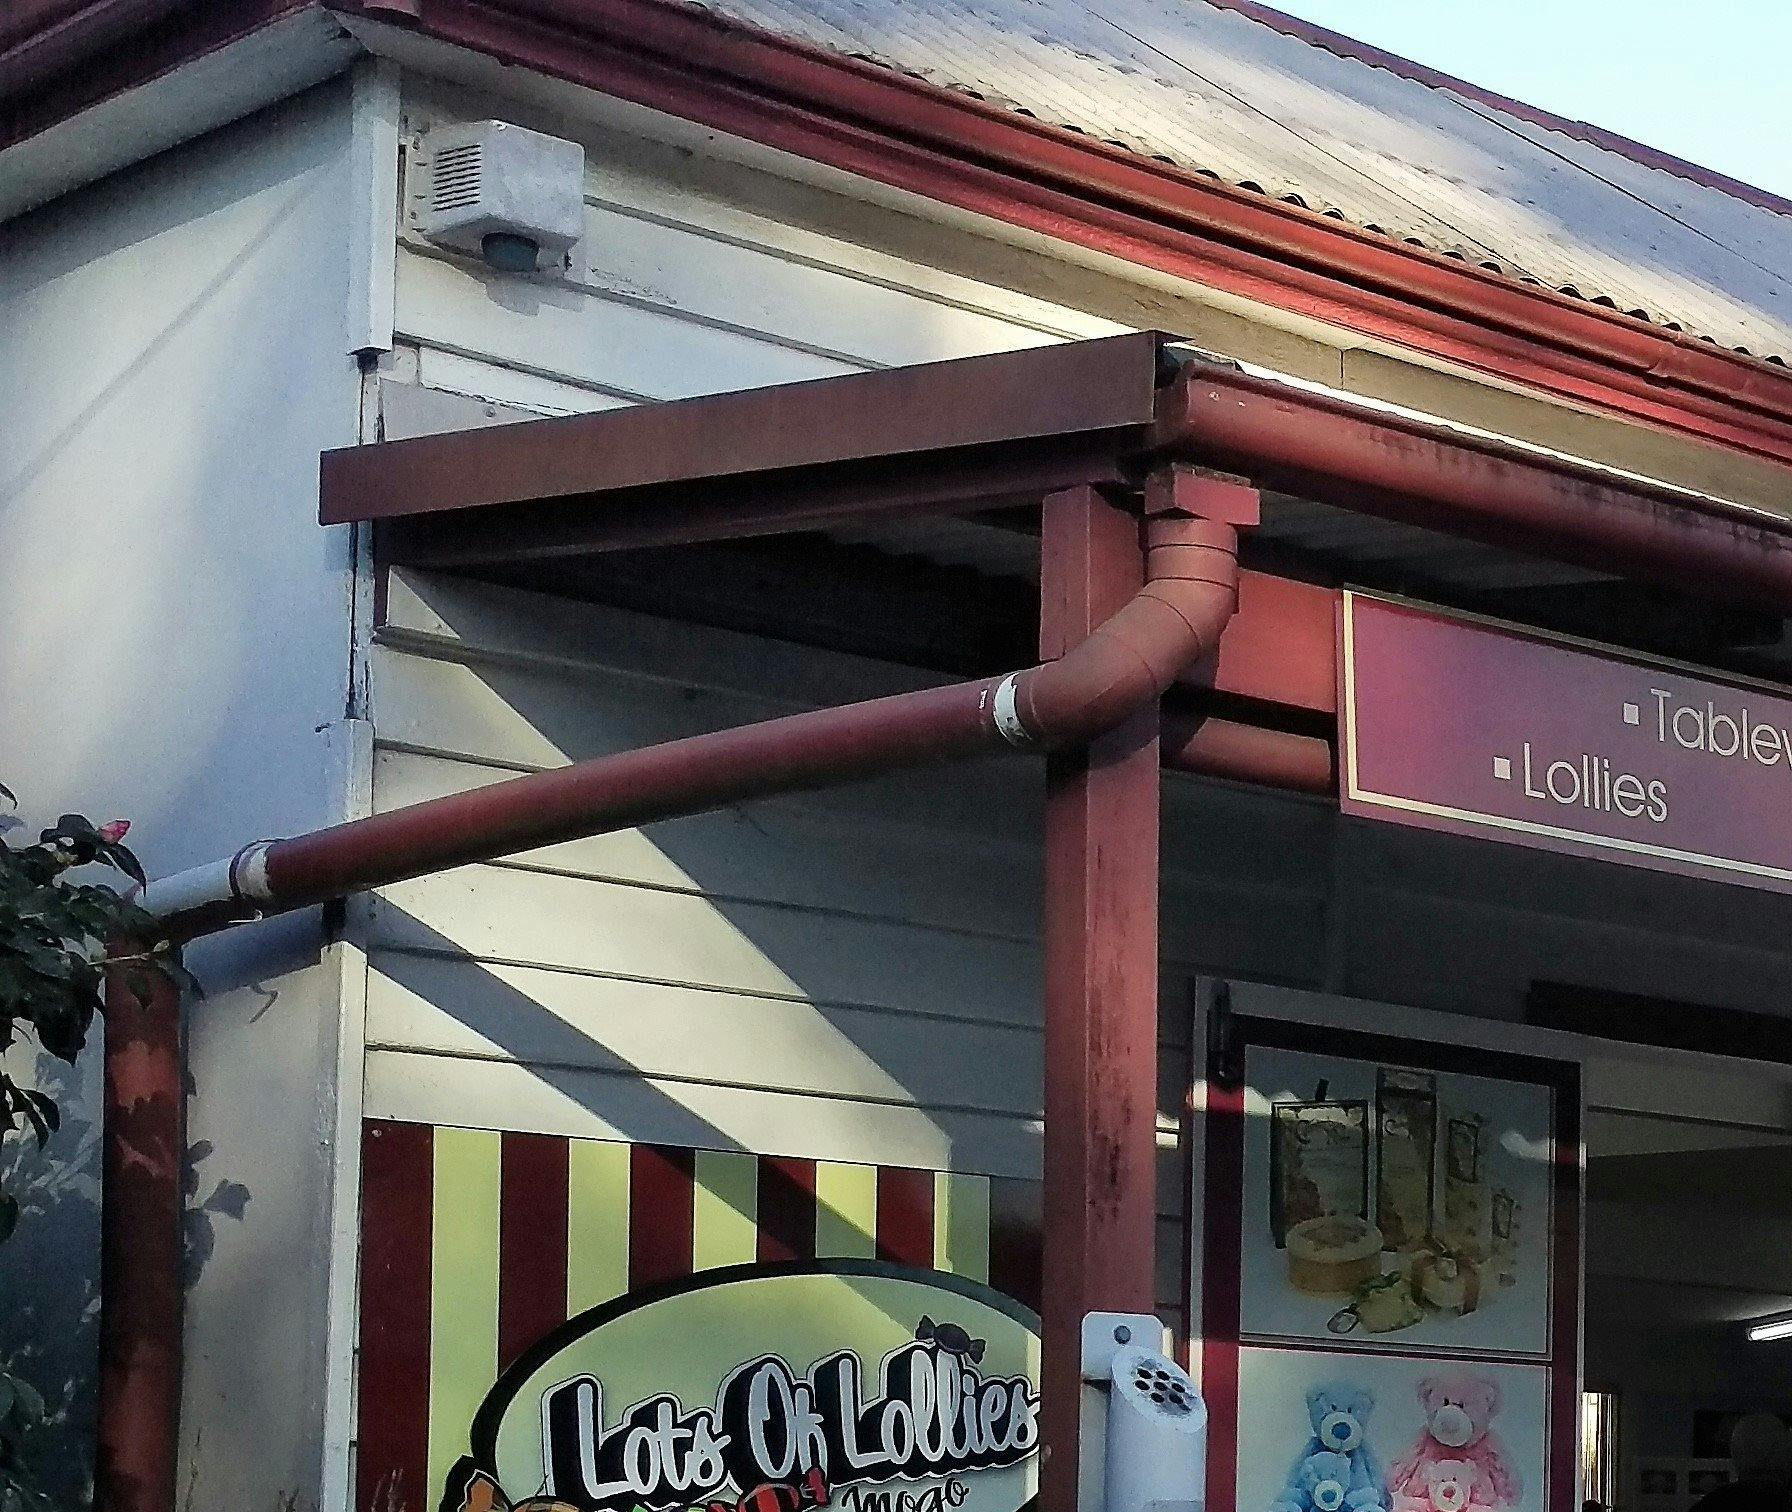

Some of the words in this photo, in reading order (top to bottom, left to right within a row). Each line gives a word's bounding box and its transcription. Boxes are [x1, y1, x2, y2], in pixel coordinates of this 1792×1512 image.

[1523, 741, 1669, 823] Lollies
[560, 1373, 731, 1502] Lots
[838, 1346, 1041, 1470] Lollies
